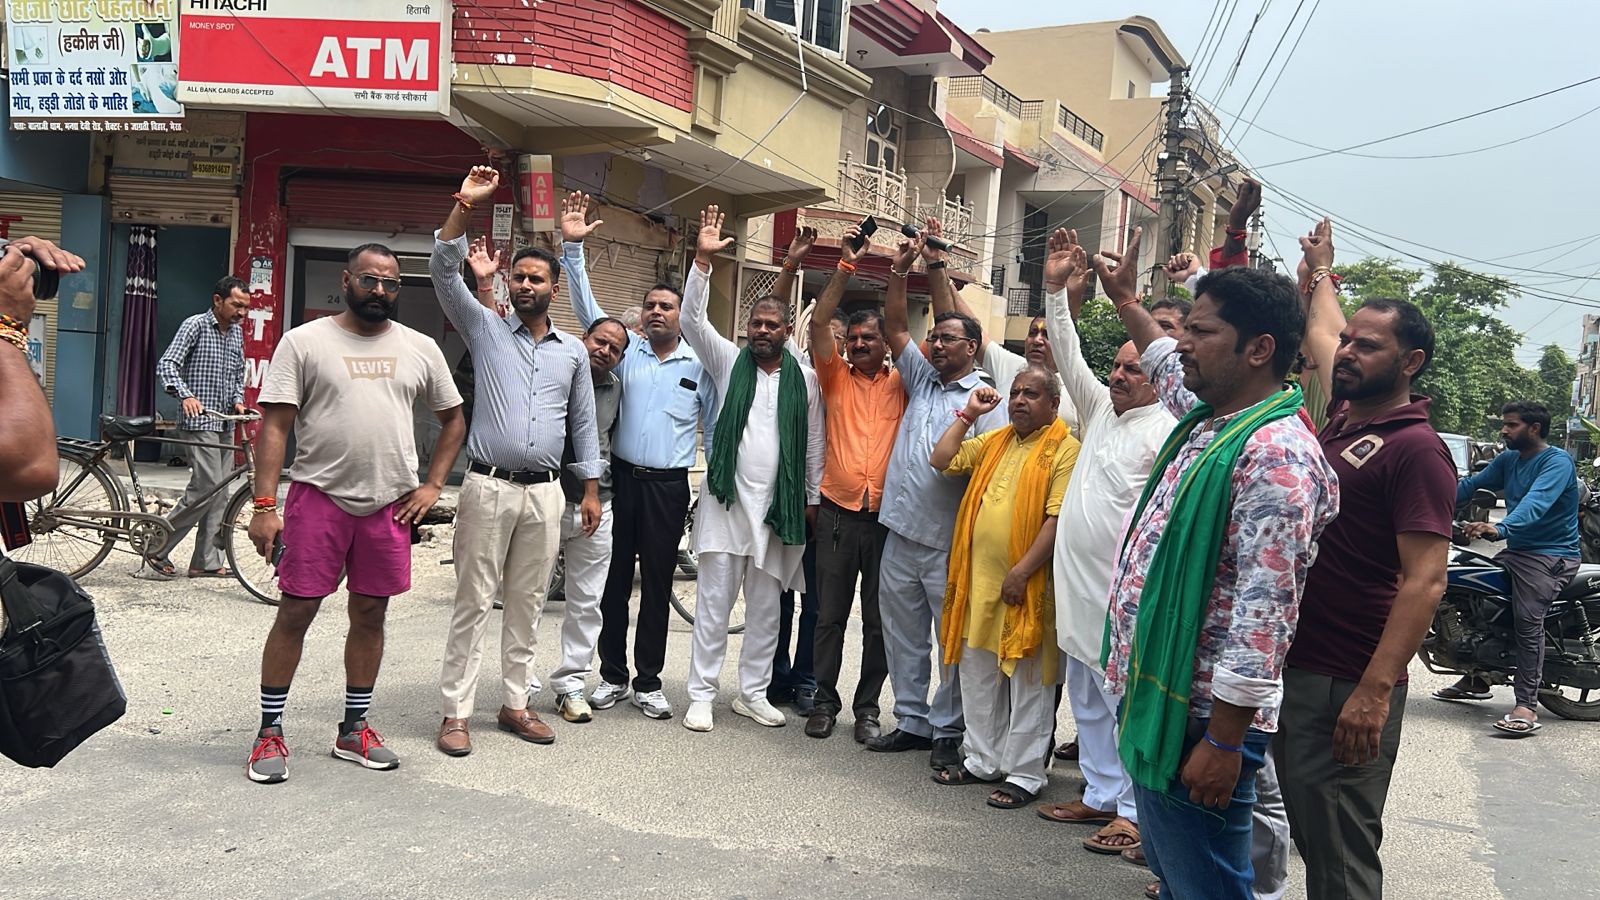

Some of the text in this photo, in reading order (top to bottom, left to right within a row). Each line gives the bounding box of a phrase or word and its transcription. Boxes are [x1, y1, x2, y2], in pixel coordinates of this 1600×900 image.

[190, 0, 267, 11] HITACHI
[406, 4, 430, 15] हिताची
[216, 22, 235, 31] SPOT
[58, 27, 125, 56] (हकीम जी)
[309, 36, 430, 81] ATM
[10, 67, 30, 86] सभी
[56, 67, 66, 86] के
[69, 67, 82, 86] दर्द
[86, 67, 106, 86] नसों
[109, 67, 128, 86] और
[200, 86, 217, 94] BANK
[218, 87, 240, 95] CARDS
[241, 88, 274, 96] ACCEPTED
[353, 90, 428, 101] सभी बैंक कार्ड स्वीकार्य
[12, 92, 34, 114] मोच,
[89, 92, 99, 111] के
[102, 92, 129, 111] माहिर
[124, 122, 129, 131] 6
[535, 175, 549, 216] ATM
[327, 295, 341, 304] 24
[351, 360, 391, 374] LEVI'S
